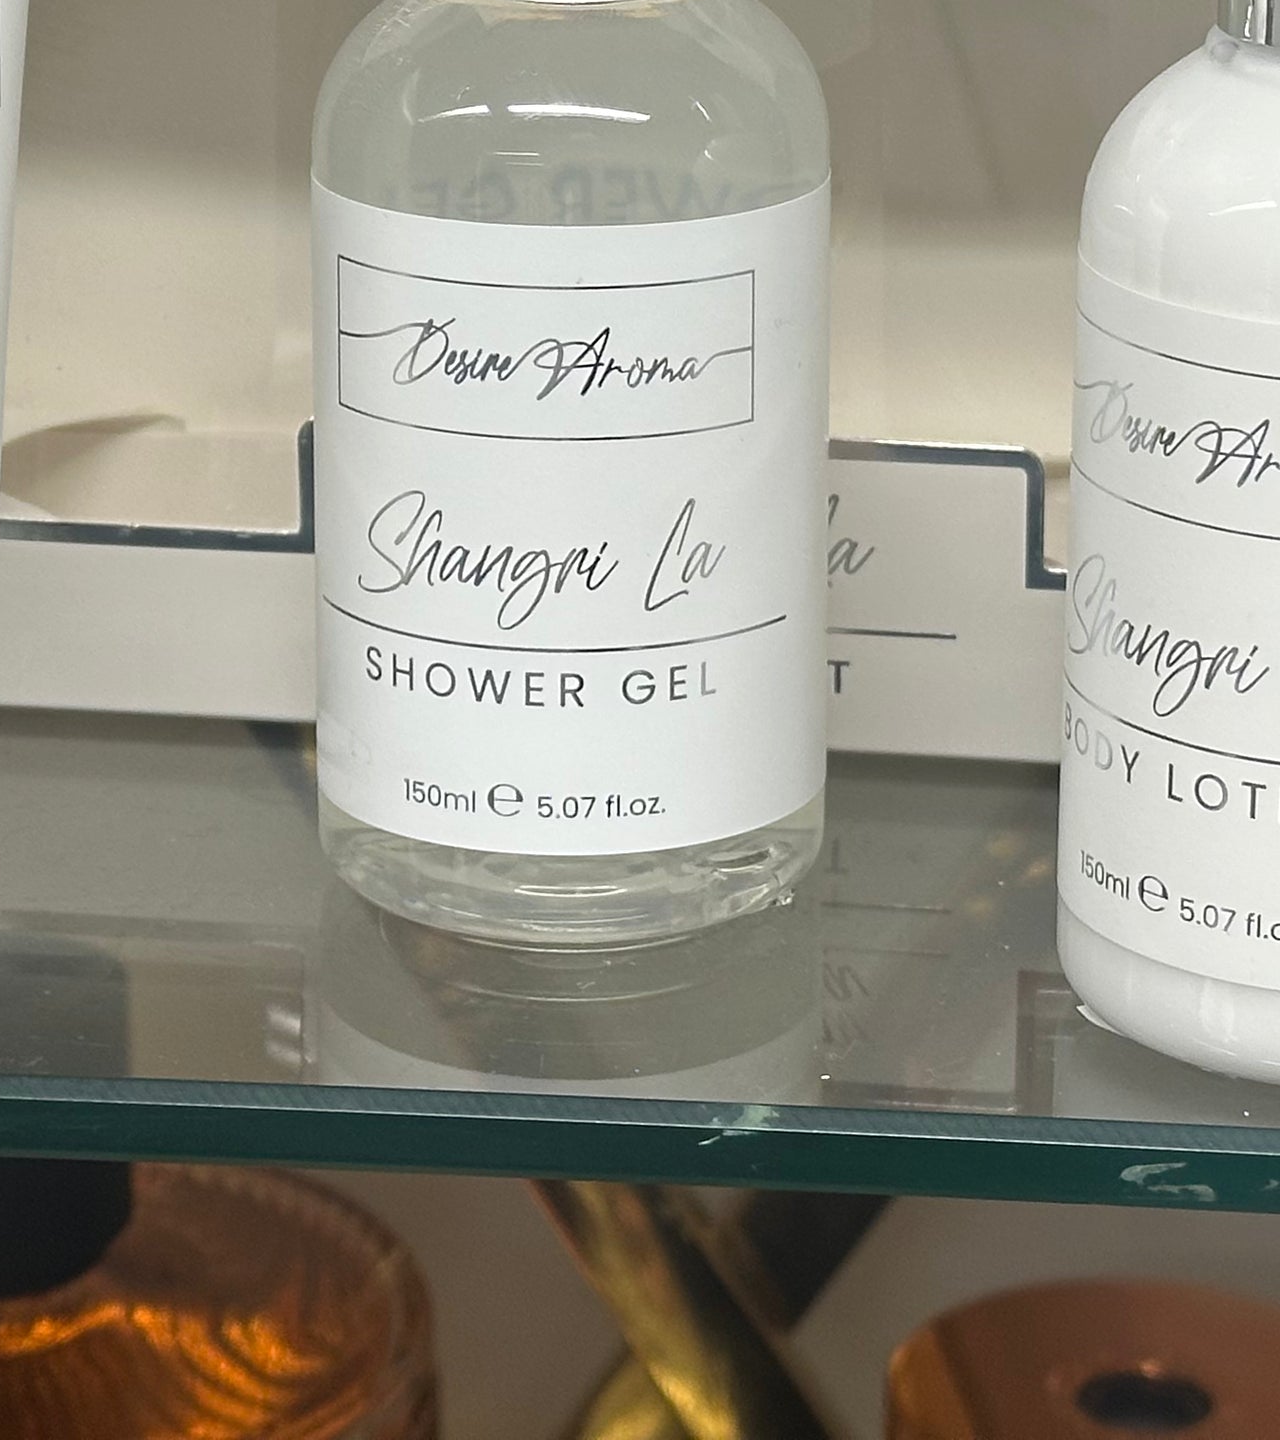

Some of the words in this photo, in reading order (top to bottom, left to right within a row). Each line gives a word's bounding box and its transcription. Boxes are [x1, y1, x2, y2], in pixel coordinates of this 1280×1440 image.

[392, 316, 520, 387] Desire
[532, 325, 708, 402] Aroma
[1088, 378, 1179, 457] Desire
[357, 489, 621, 631] Shangri
[643, 498, 727, 612] La
[364, 645, 587, 708] SHOWER
[621, 661, 718, 706] GEL
[1067, 552, 1271, 719] Shangri
[1064, 700, 1140, 785] BODY
[402, 777, 477, 815] 150ml
[536, 793, 597, 820] 5.07
[605, 792, 668, 818] fl.oz.
[1080, 849, 1131, 901] 150ml
[1178, 897, 1237, 934] 5.07
